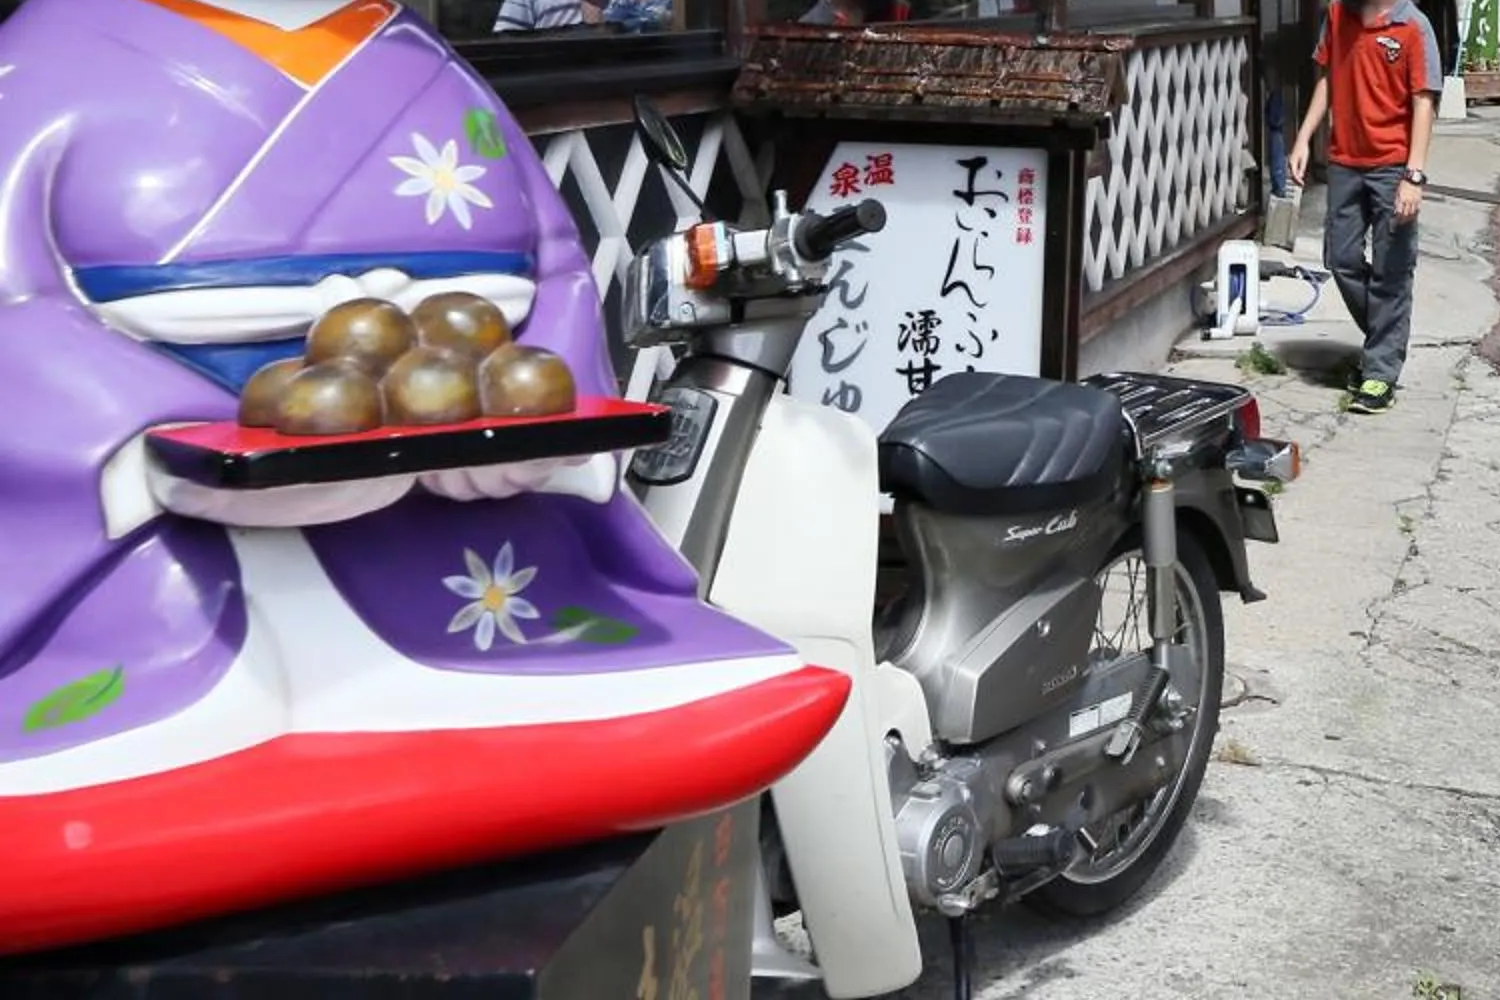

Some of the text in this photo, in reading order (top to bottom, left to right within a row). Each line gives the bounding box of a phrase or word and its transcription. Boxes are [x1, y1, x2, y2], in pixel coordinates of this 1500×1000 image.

[829, 152, 895, 198] 温泉
[1016, 167, 1035, 245] 商標登録
[940, 155, 1009, 373] おいらんふ
[1002, 509, 1078, 541] Super Cub
